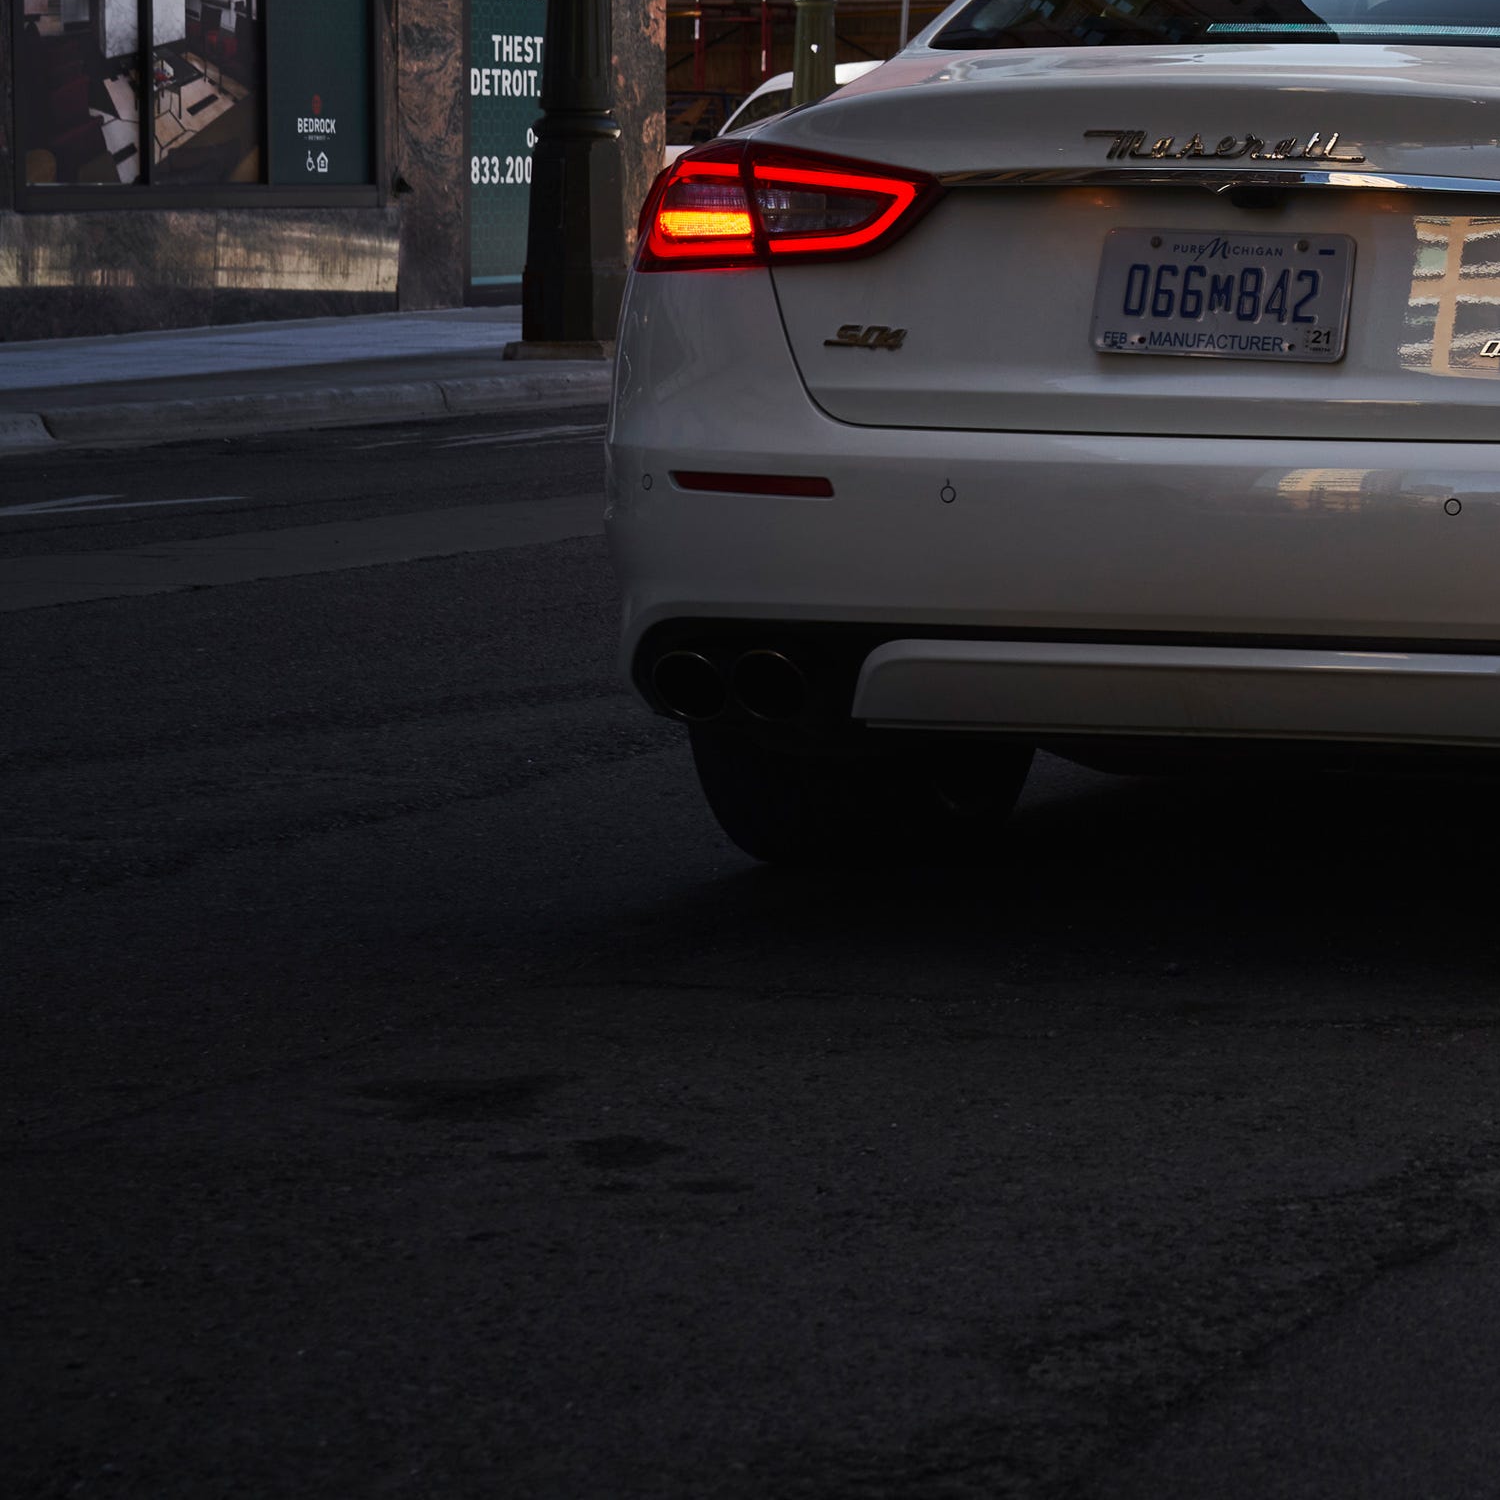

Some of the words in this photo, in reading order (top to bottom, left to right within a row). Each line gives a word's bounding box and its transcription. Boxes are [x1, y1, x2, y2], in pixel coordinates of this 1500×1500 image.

[297, 117, 336, 134] BEDROCK
[1084, 130, 1366, 163] Maserati
[1173, 244, 1205, 255] PURE
[1195, 237, 1283, 261] MICHIGAN
[1123, 263, 1320, 324] 066M842
[1103, 331, 1128, 344] FEB
[1150, 331, 1283, 351] MANUFACTURER
[1312, 330, 1331, 344] 21
